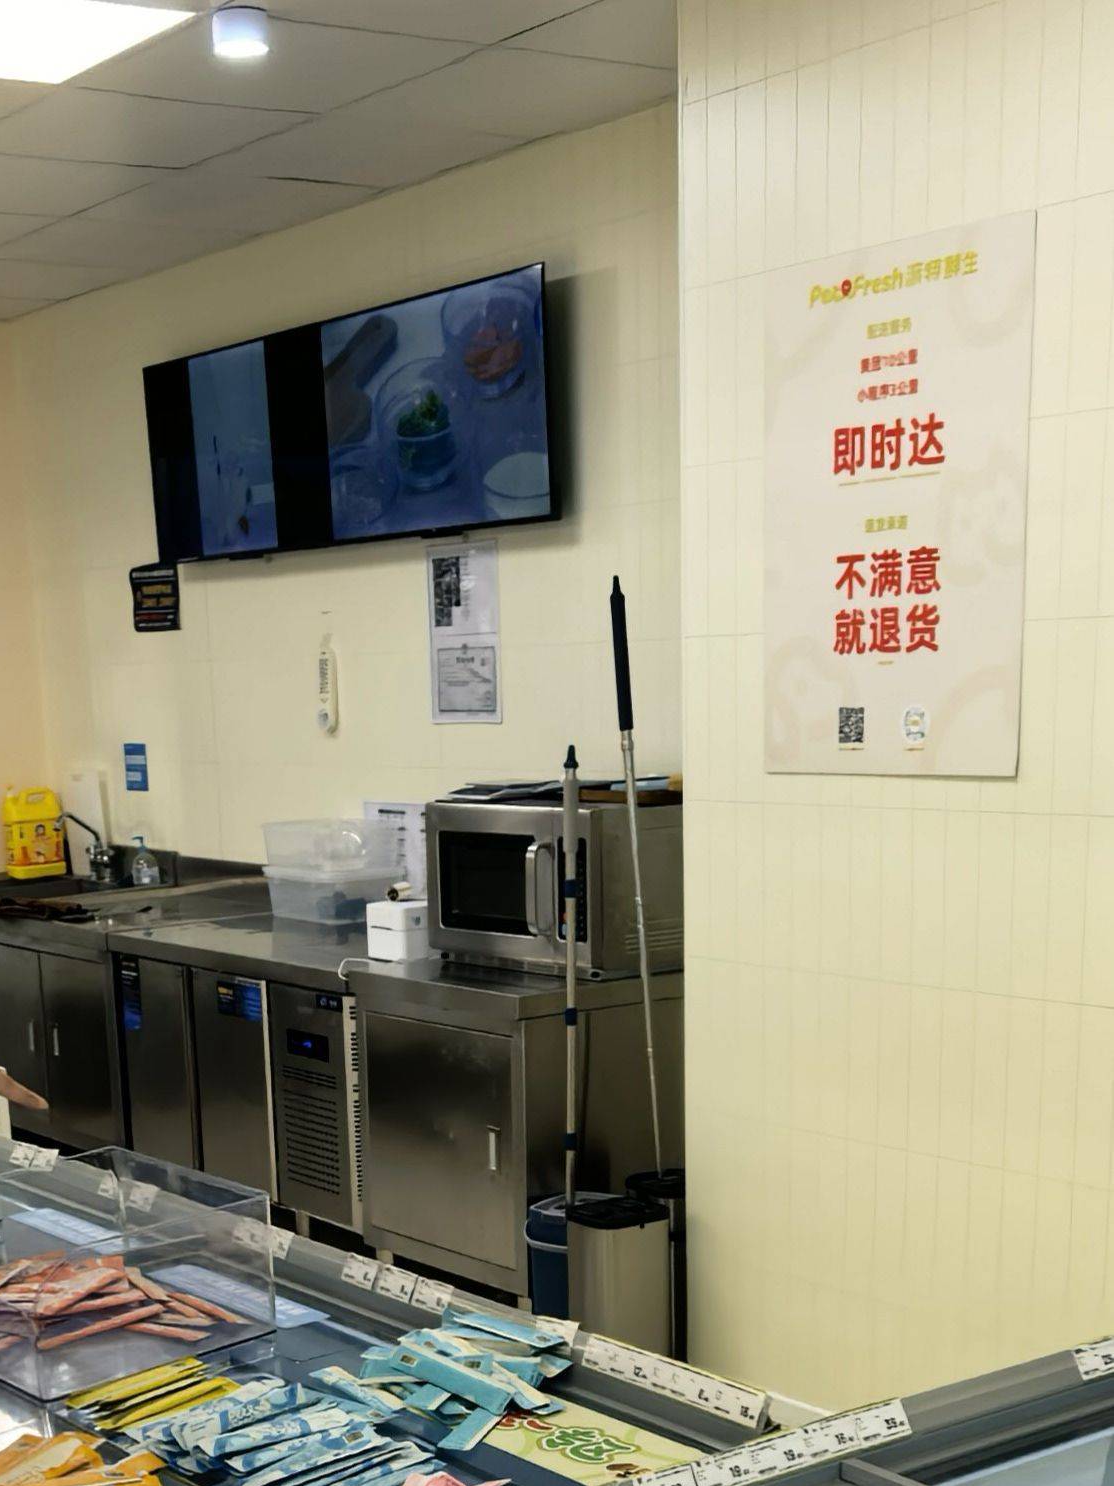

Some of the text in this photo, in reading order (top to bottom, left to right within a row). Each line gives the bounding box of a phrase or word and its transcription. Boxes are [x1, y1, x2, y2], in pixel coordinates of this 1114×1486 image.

[832, 413, 946, 476] 即时达
[834, 545, 942, 600] 不满意
[832, 604, 940, 658] 就退货
